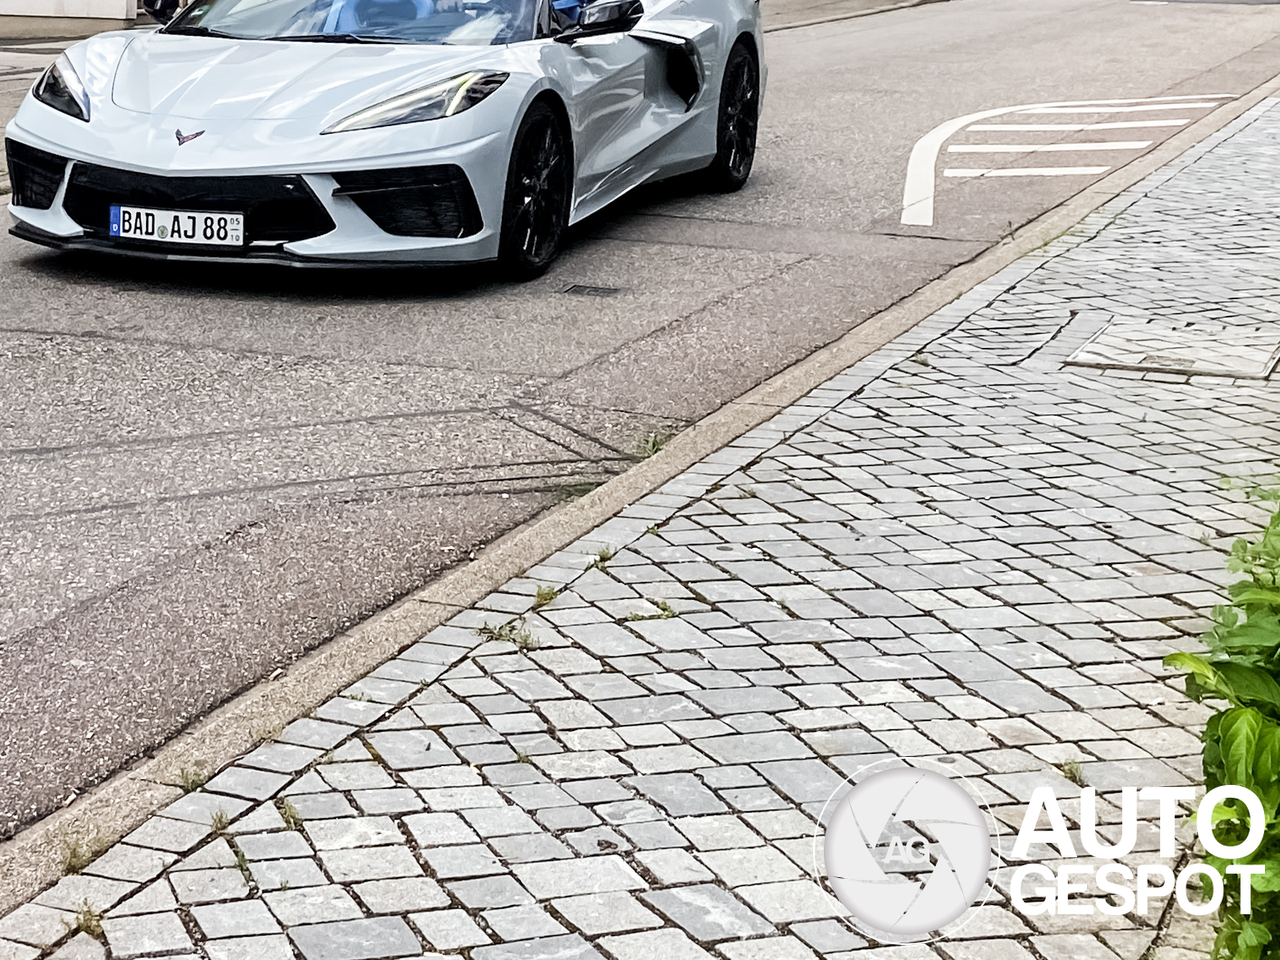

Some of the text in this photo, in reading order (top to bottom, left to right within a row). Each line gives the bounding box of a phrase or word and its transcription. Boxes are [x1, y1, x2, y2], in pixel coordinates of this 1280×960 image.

[122, 210, 228, 241] BAD AJ 88
[230, 218, 240, 226] 05
